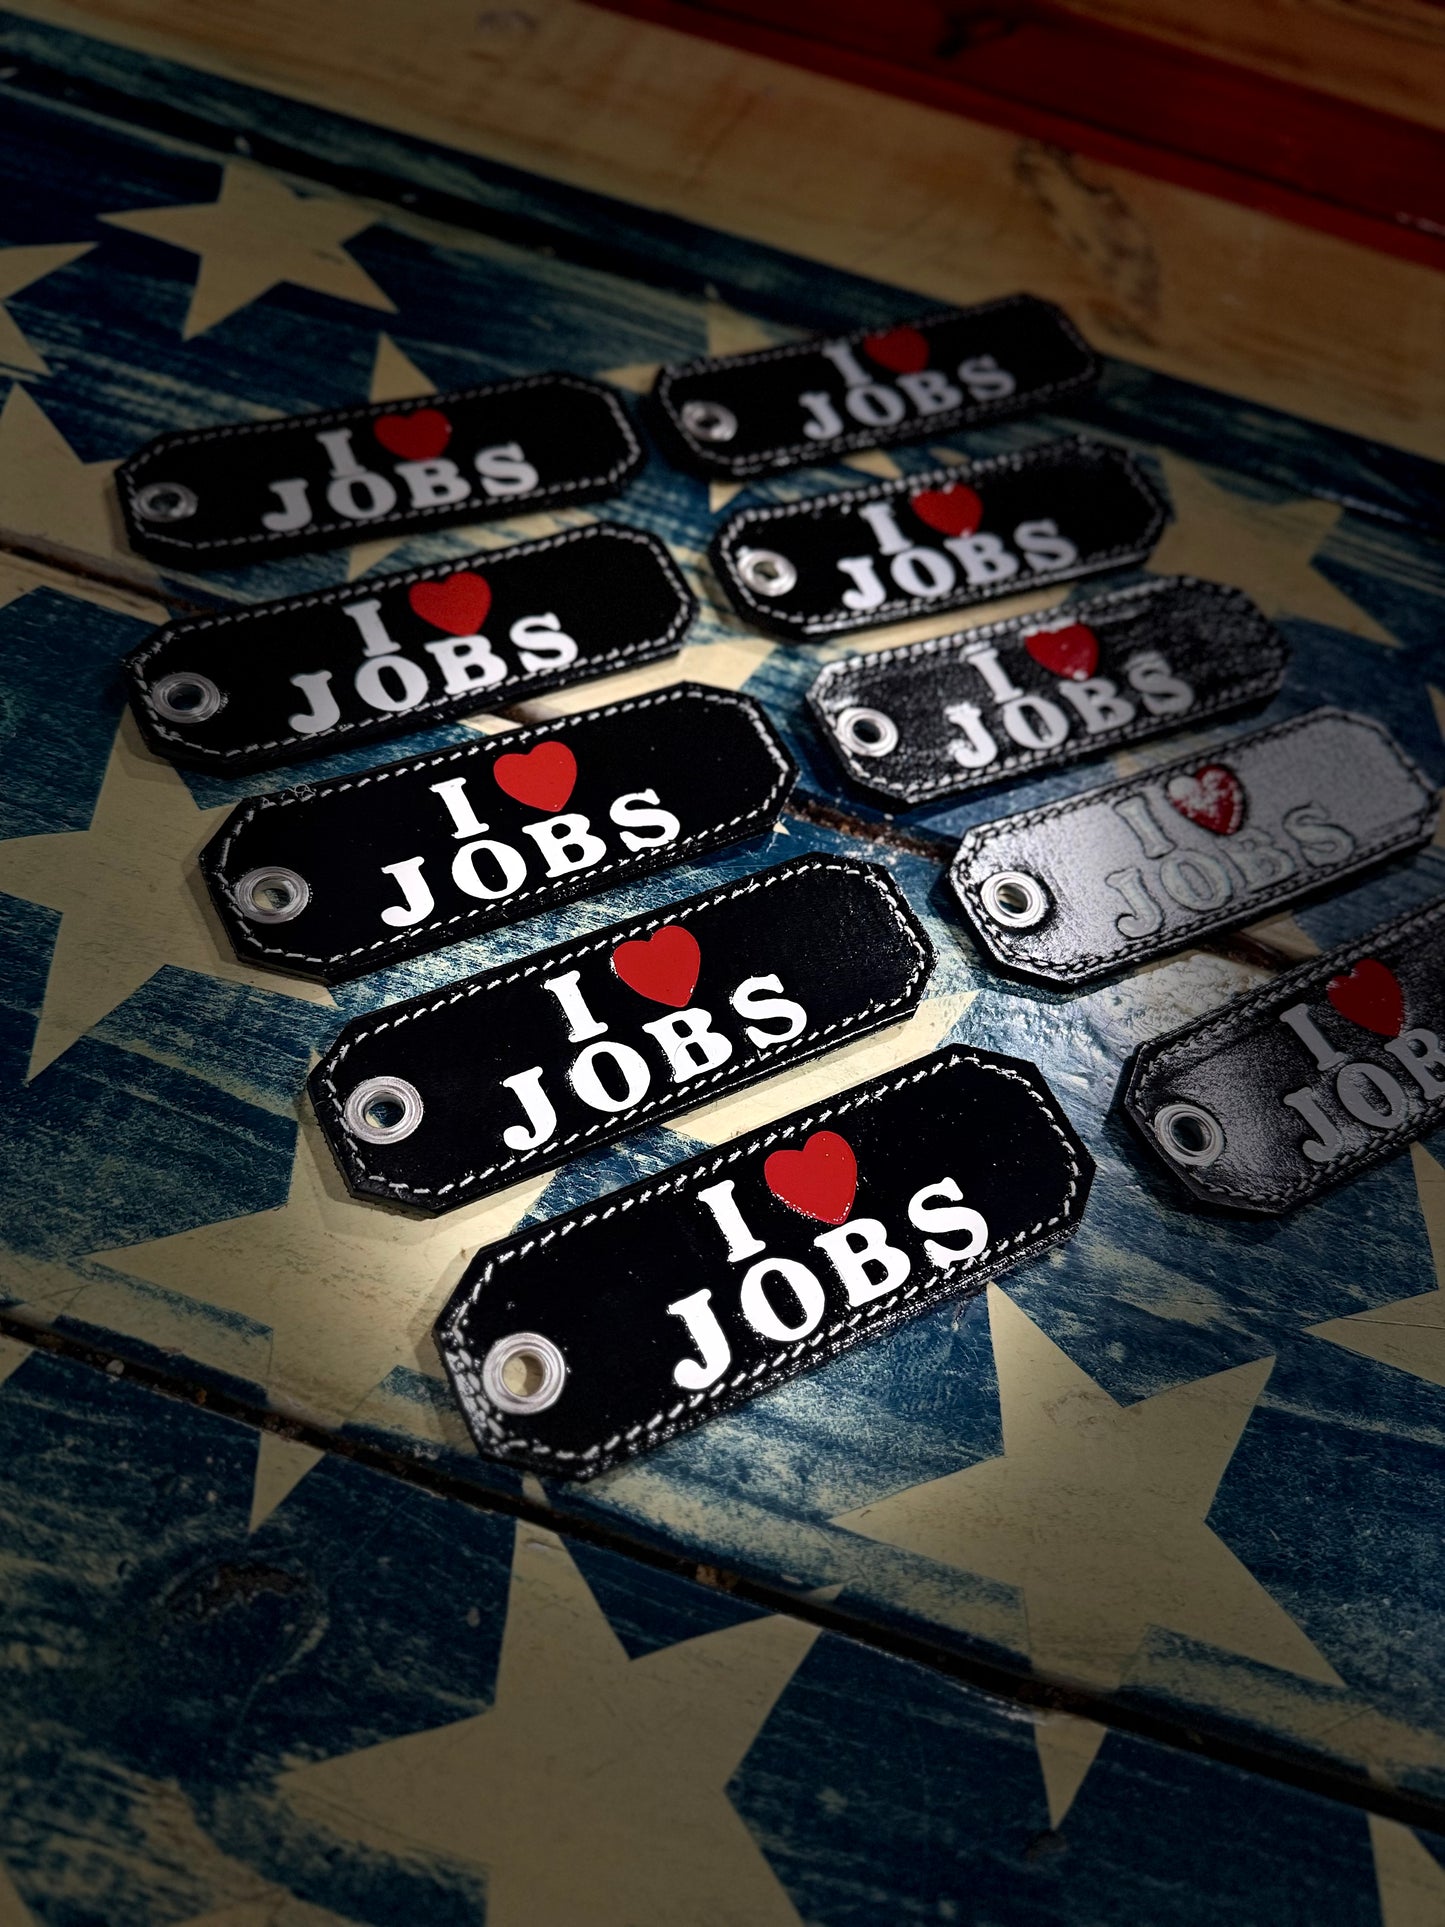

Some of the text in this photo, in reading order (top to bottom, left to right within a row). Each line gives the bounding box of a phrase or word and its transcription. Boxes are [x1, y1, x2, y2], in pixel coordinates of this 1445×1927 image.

[799, 354, 1016, 440] JOBS
[821, 340, 866, 388] I
[261, 442, 540, 532] JOBS
[315, 428, 369, 477] I
[838, 518, 1077, 611] JOBS
[859, 503, 912, 555] I
[341, 599, 401, 658] I
[288, 612, 579, 734] JOBS
[945, 649, 1195, 770] JOBS
[960, 643, 1022, 703] I
[430, 777, 490, 839] I
[1112, 795, 1176, 860] I
[380, 788, 681, 927] JOBS
[1105, 803, 1357, 939] JOBS
[544, 969, 608, 1045] I
[1280, 1003, 1345, 1072] I
[501, 973, 808, 1153] JOBS
[697, 1179, 766, 1263] I
[665, 1176, 989, 1392] JOBS
